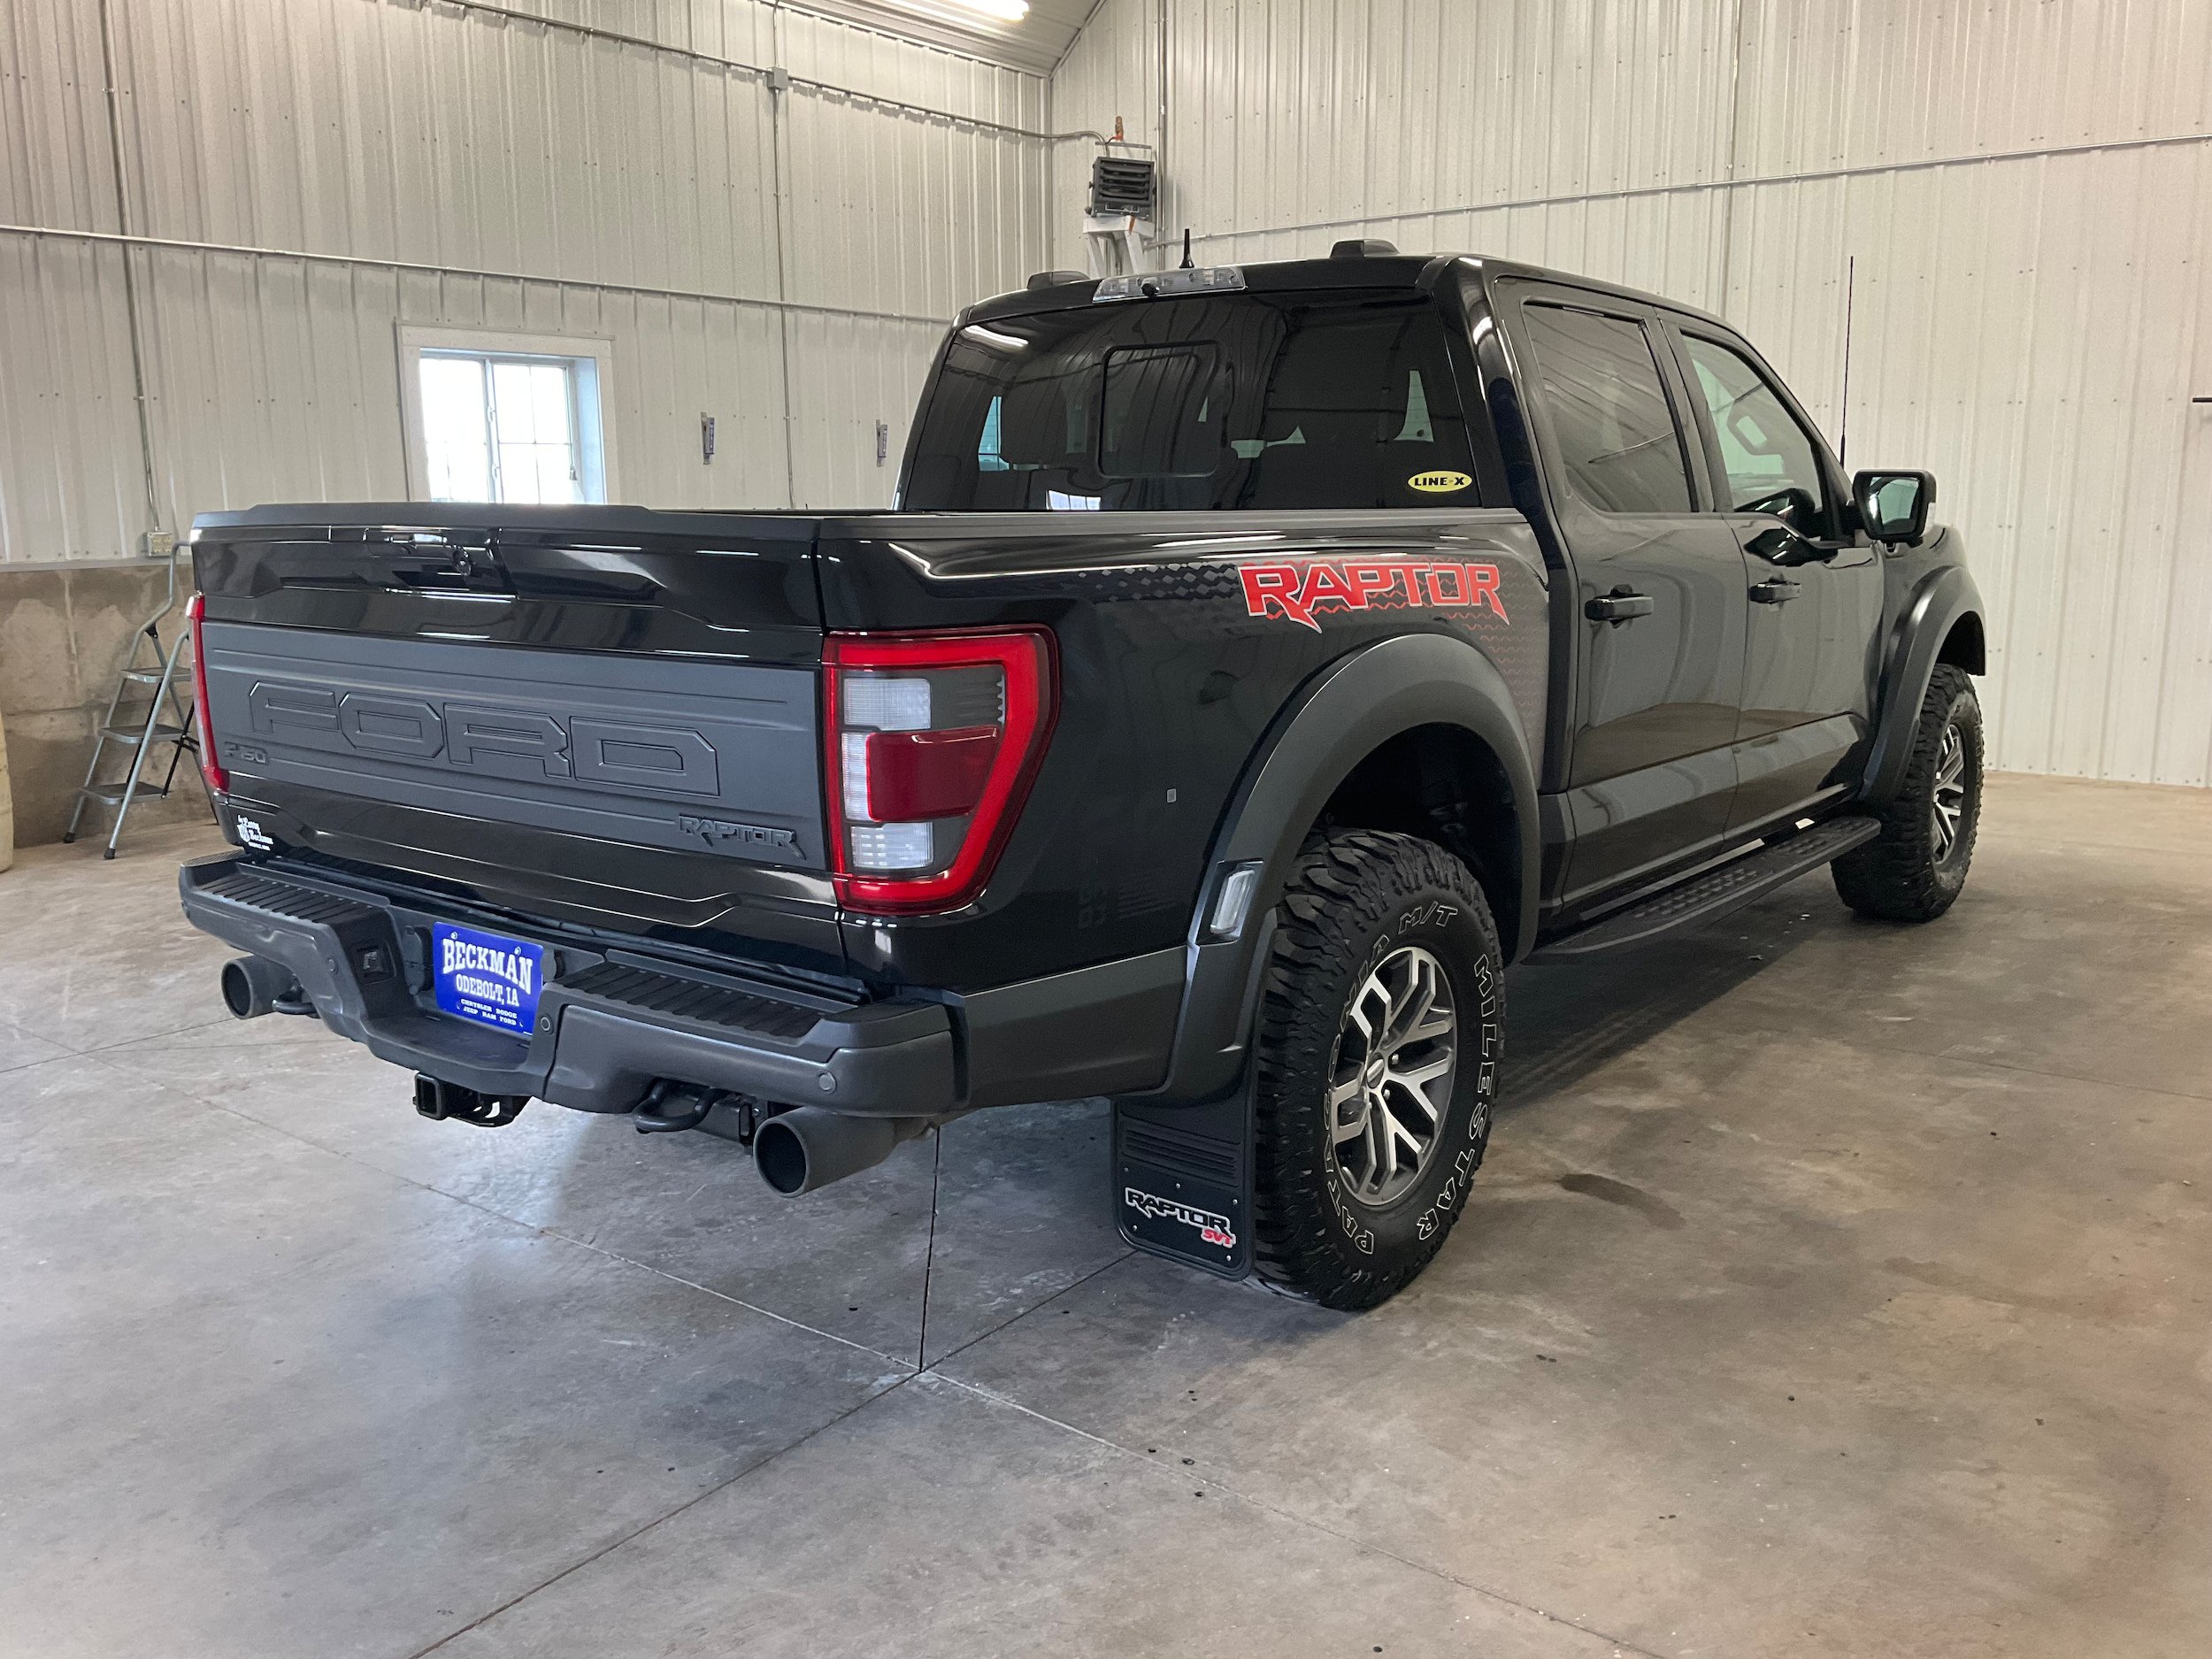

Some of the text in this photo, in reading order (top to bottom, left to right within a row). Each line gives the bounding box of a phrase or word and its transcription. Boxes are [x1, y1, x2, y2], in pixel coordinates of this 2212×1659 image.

[1413, 474, 1465, 488] LINE-X
[1238, 562, 1509, 634] RAPTOR
[249, 680, 720, 797] FORD
[679, 813, 807, 861] RAPTOR
[1397, 901, 1459, 935] M/T
[442, 938, 534, 995] BECKMAN
[456, 973, 520, 1007] ODEBOLT, IA
[460, 998, 518, 1018] CHRYSLER DODGE
[463, 1006, 517, 1025] JEEP RAM FORD
[1416, 953, 1497, 1240] MILESTAR
[1125, 1187, 1236, 1244] RAPTOR
[1201, 1228, 1233, 1248] SVT
